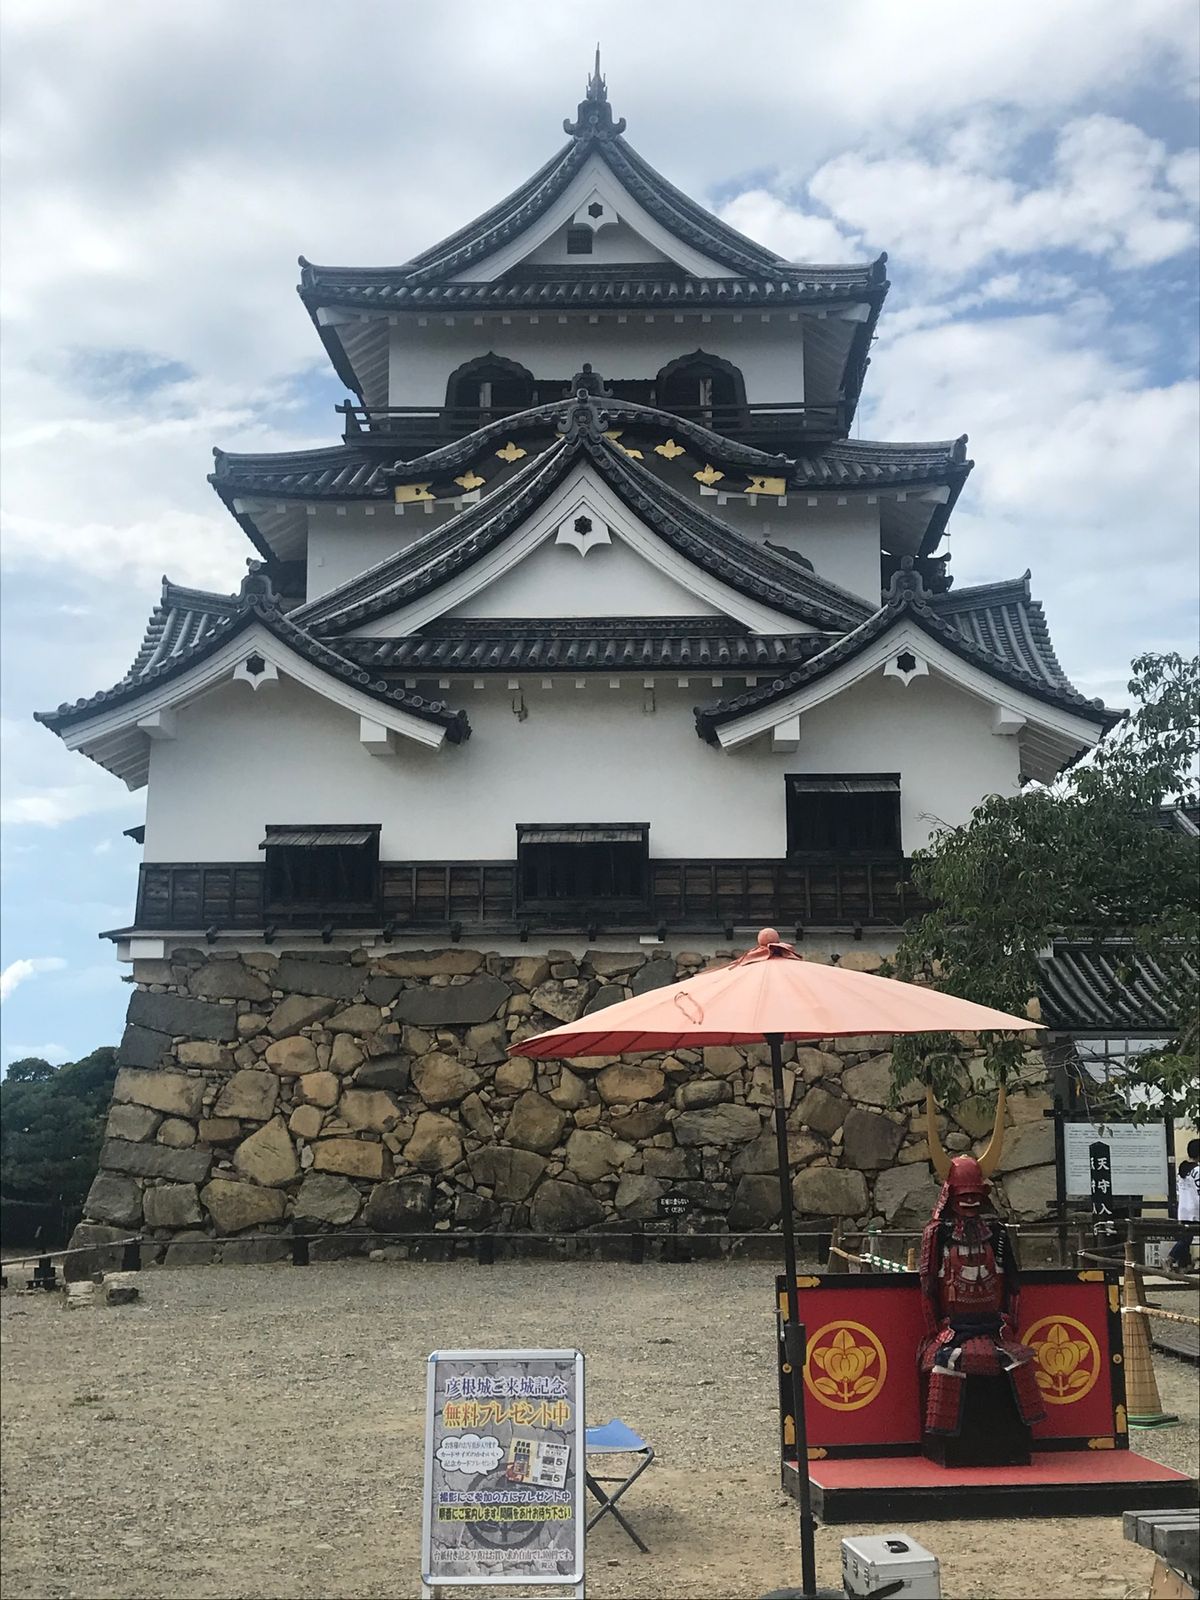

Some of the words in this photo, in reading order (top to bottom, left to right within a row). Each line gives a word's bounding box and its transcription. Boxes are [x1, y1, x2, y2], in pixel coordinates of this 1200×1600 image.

[446, 1377, 567, 1397] 彦根城ご来城記念
[444, 1402, 569, 1427] 無料プレゼント中
[439, 1491, 571, 1503] 撮影にご参加の方にプレゼント中
